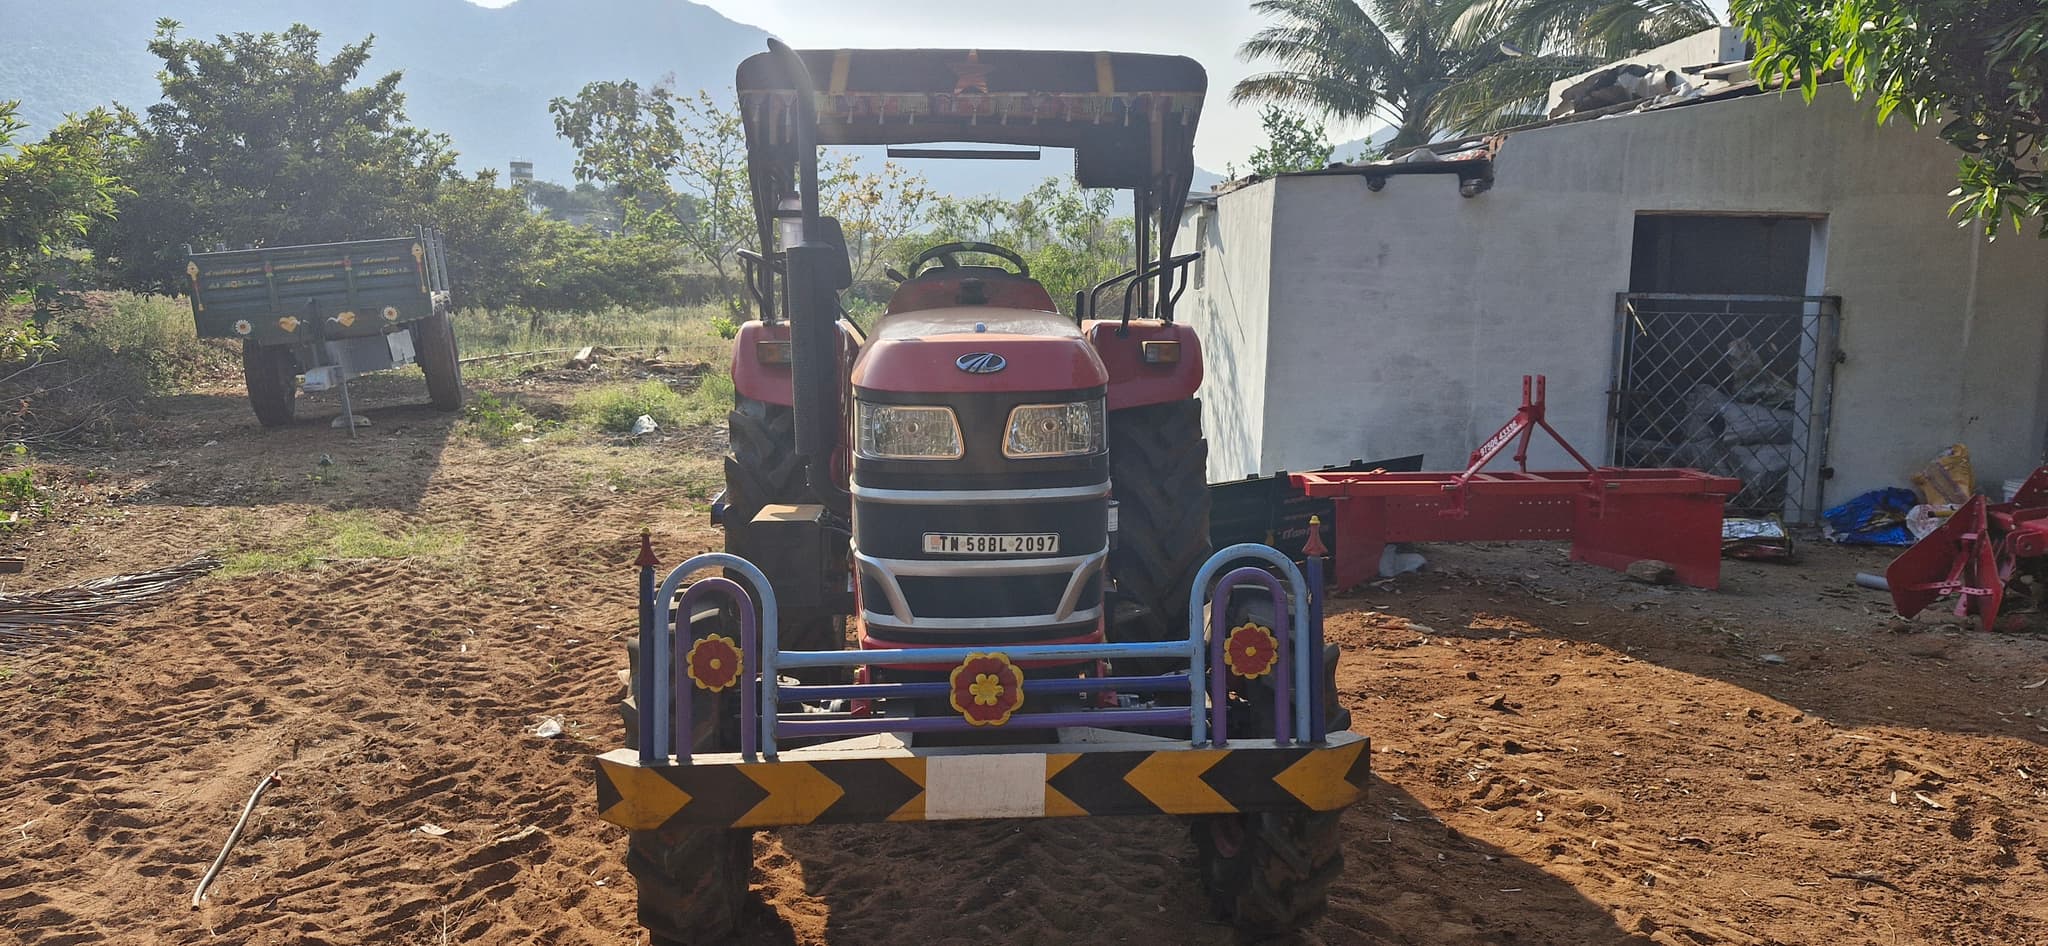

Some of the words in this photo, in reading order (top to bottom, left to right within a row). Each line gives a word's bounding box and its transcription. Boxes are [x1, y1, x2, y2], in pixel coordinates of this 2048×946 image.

[940, 536, 959, 551] TN
[966, 536, 1007, 552] 58BL
[1015, 536, 1056, 552] 2097
